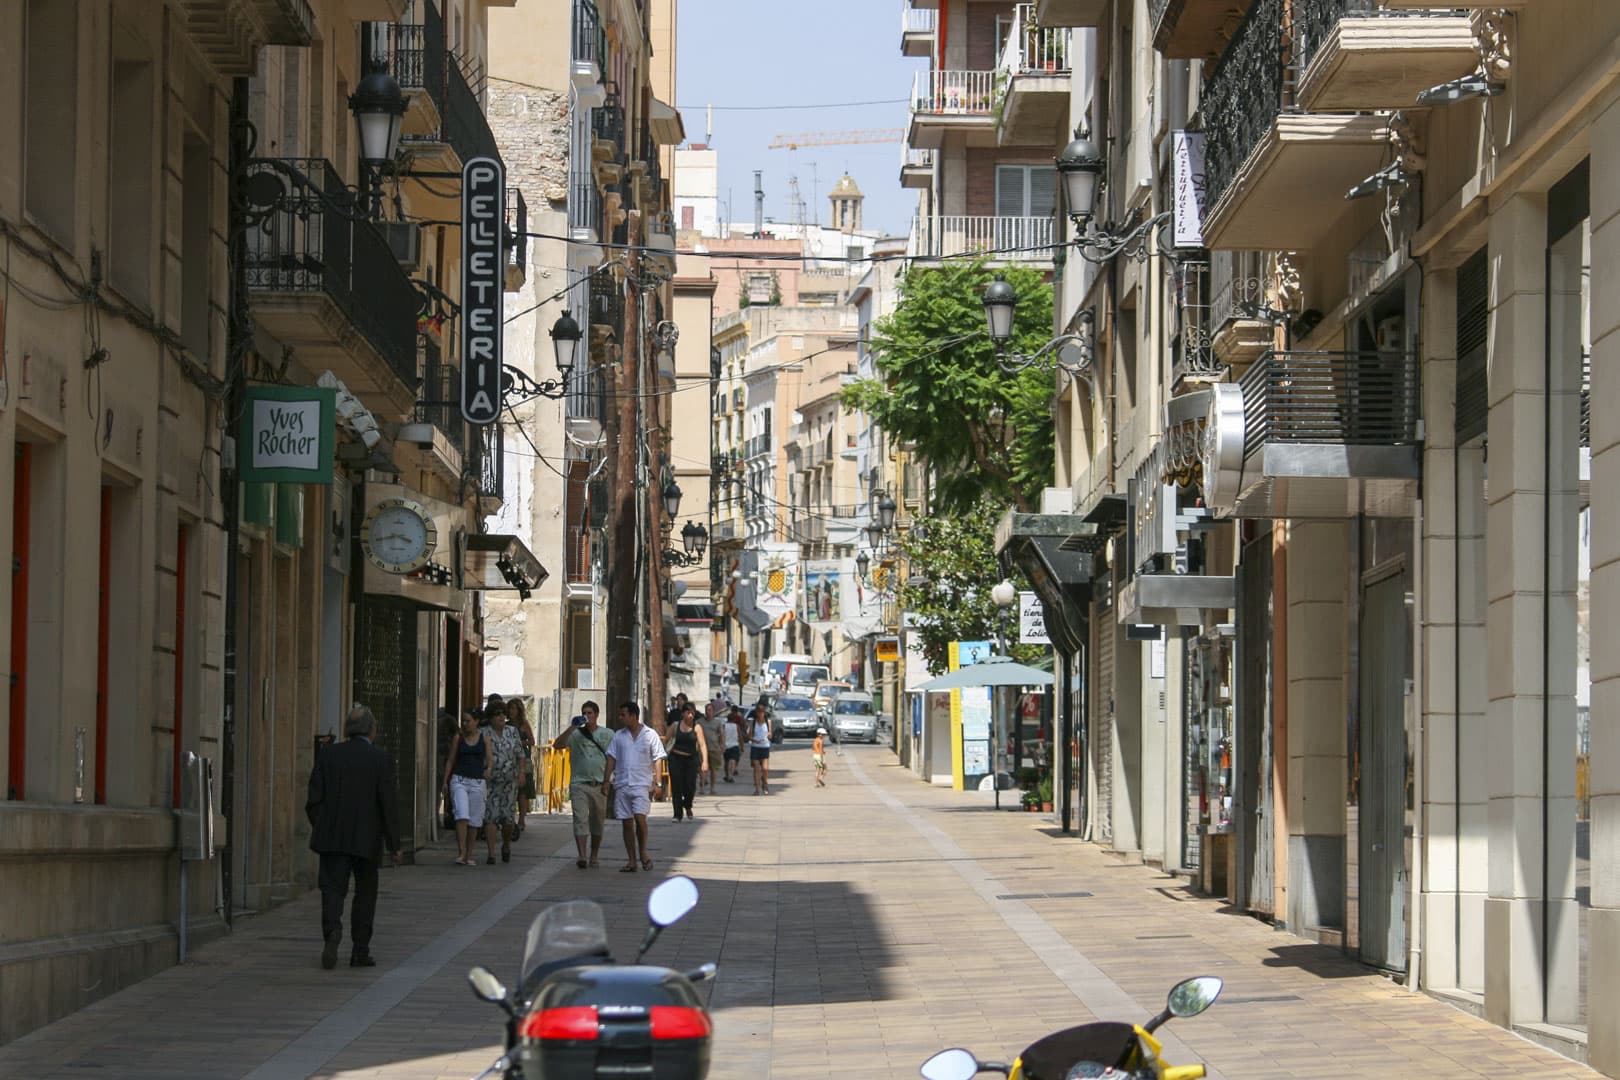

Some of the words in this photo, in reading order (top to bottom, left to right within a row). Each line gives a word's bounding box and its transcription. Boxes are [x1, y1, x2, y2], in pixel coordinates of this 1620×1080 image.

[270, 407, 305, 435] Yves
[258, 429, 316, 456] Rocher
[1023, 608, 1043, 617] tien
[1031, 618, 1042, 627] de
